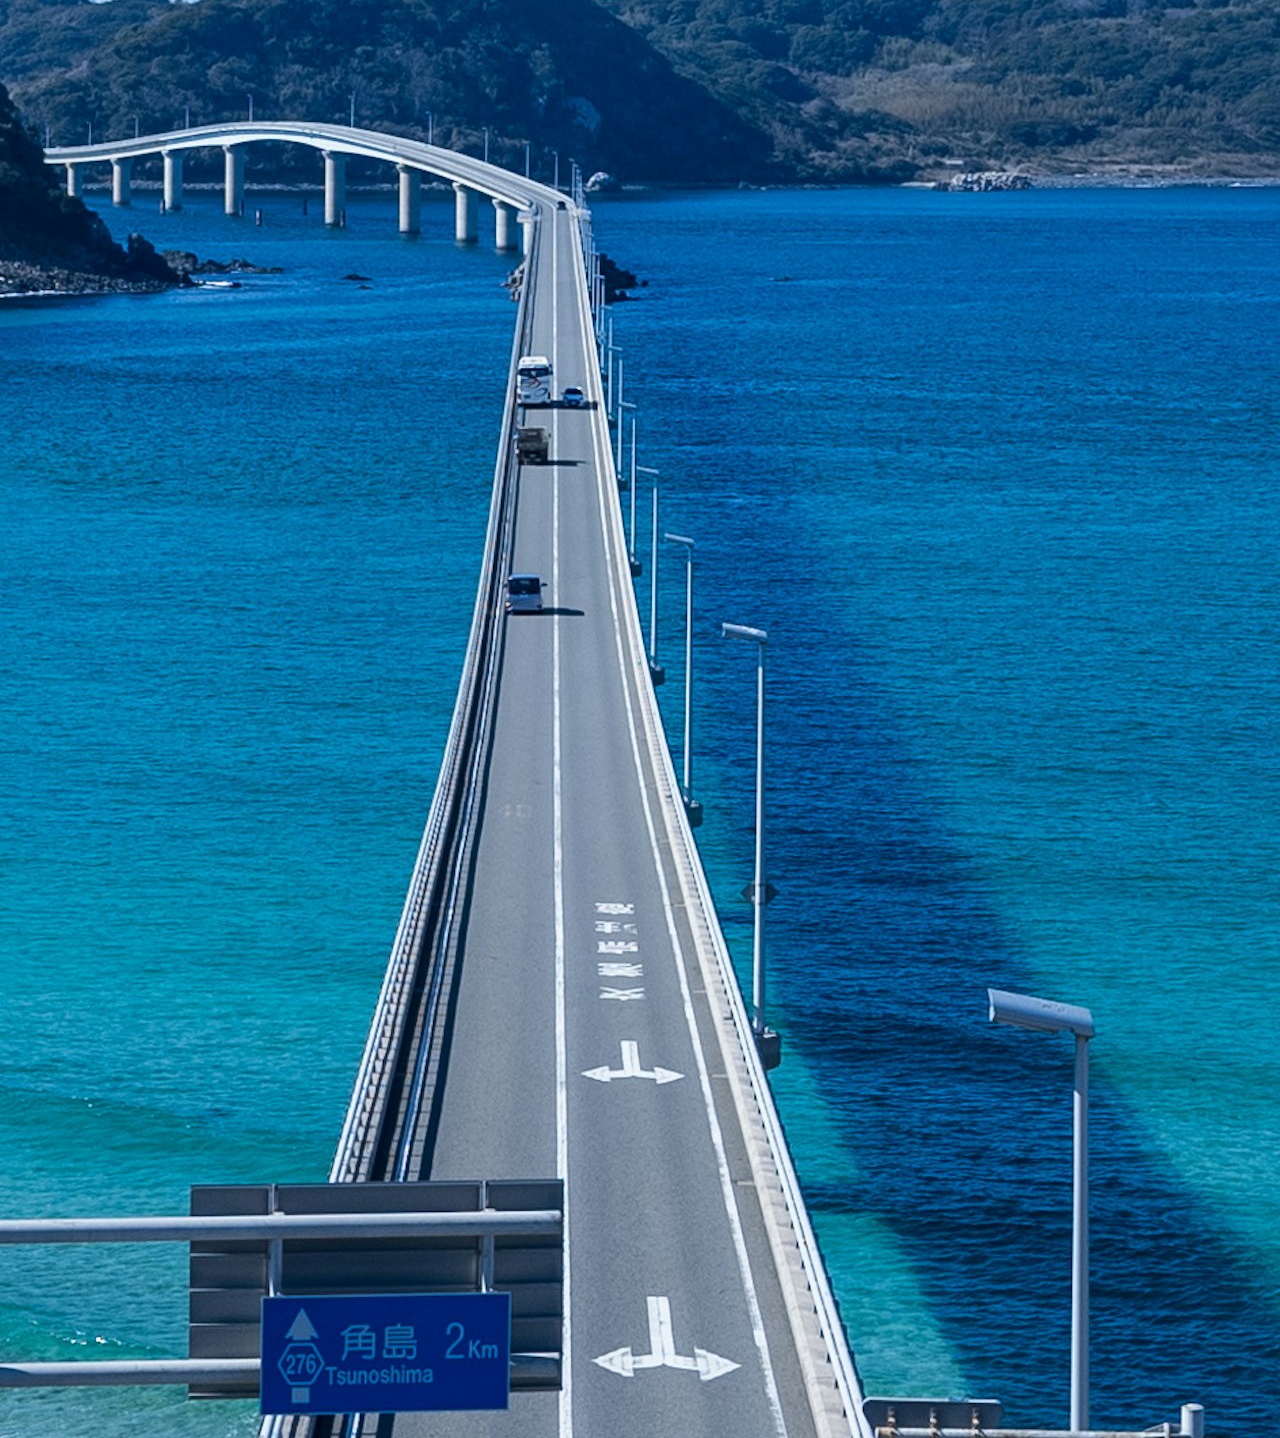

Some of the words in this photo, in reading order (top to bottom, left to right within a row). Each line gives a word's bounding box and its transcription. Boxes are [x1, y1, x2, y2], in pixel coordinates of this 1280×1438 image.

[340, 1323, 418, 1361] 角島
[286, 1354, 317, 1375] 276
[325, 1364, 434, 1385] Tsunoshima
